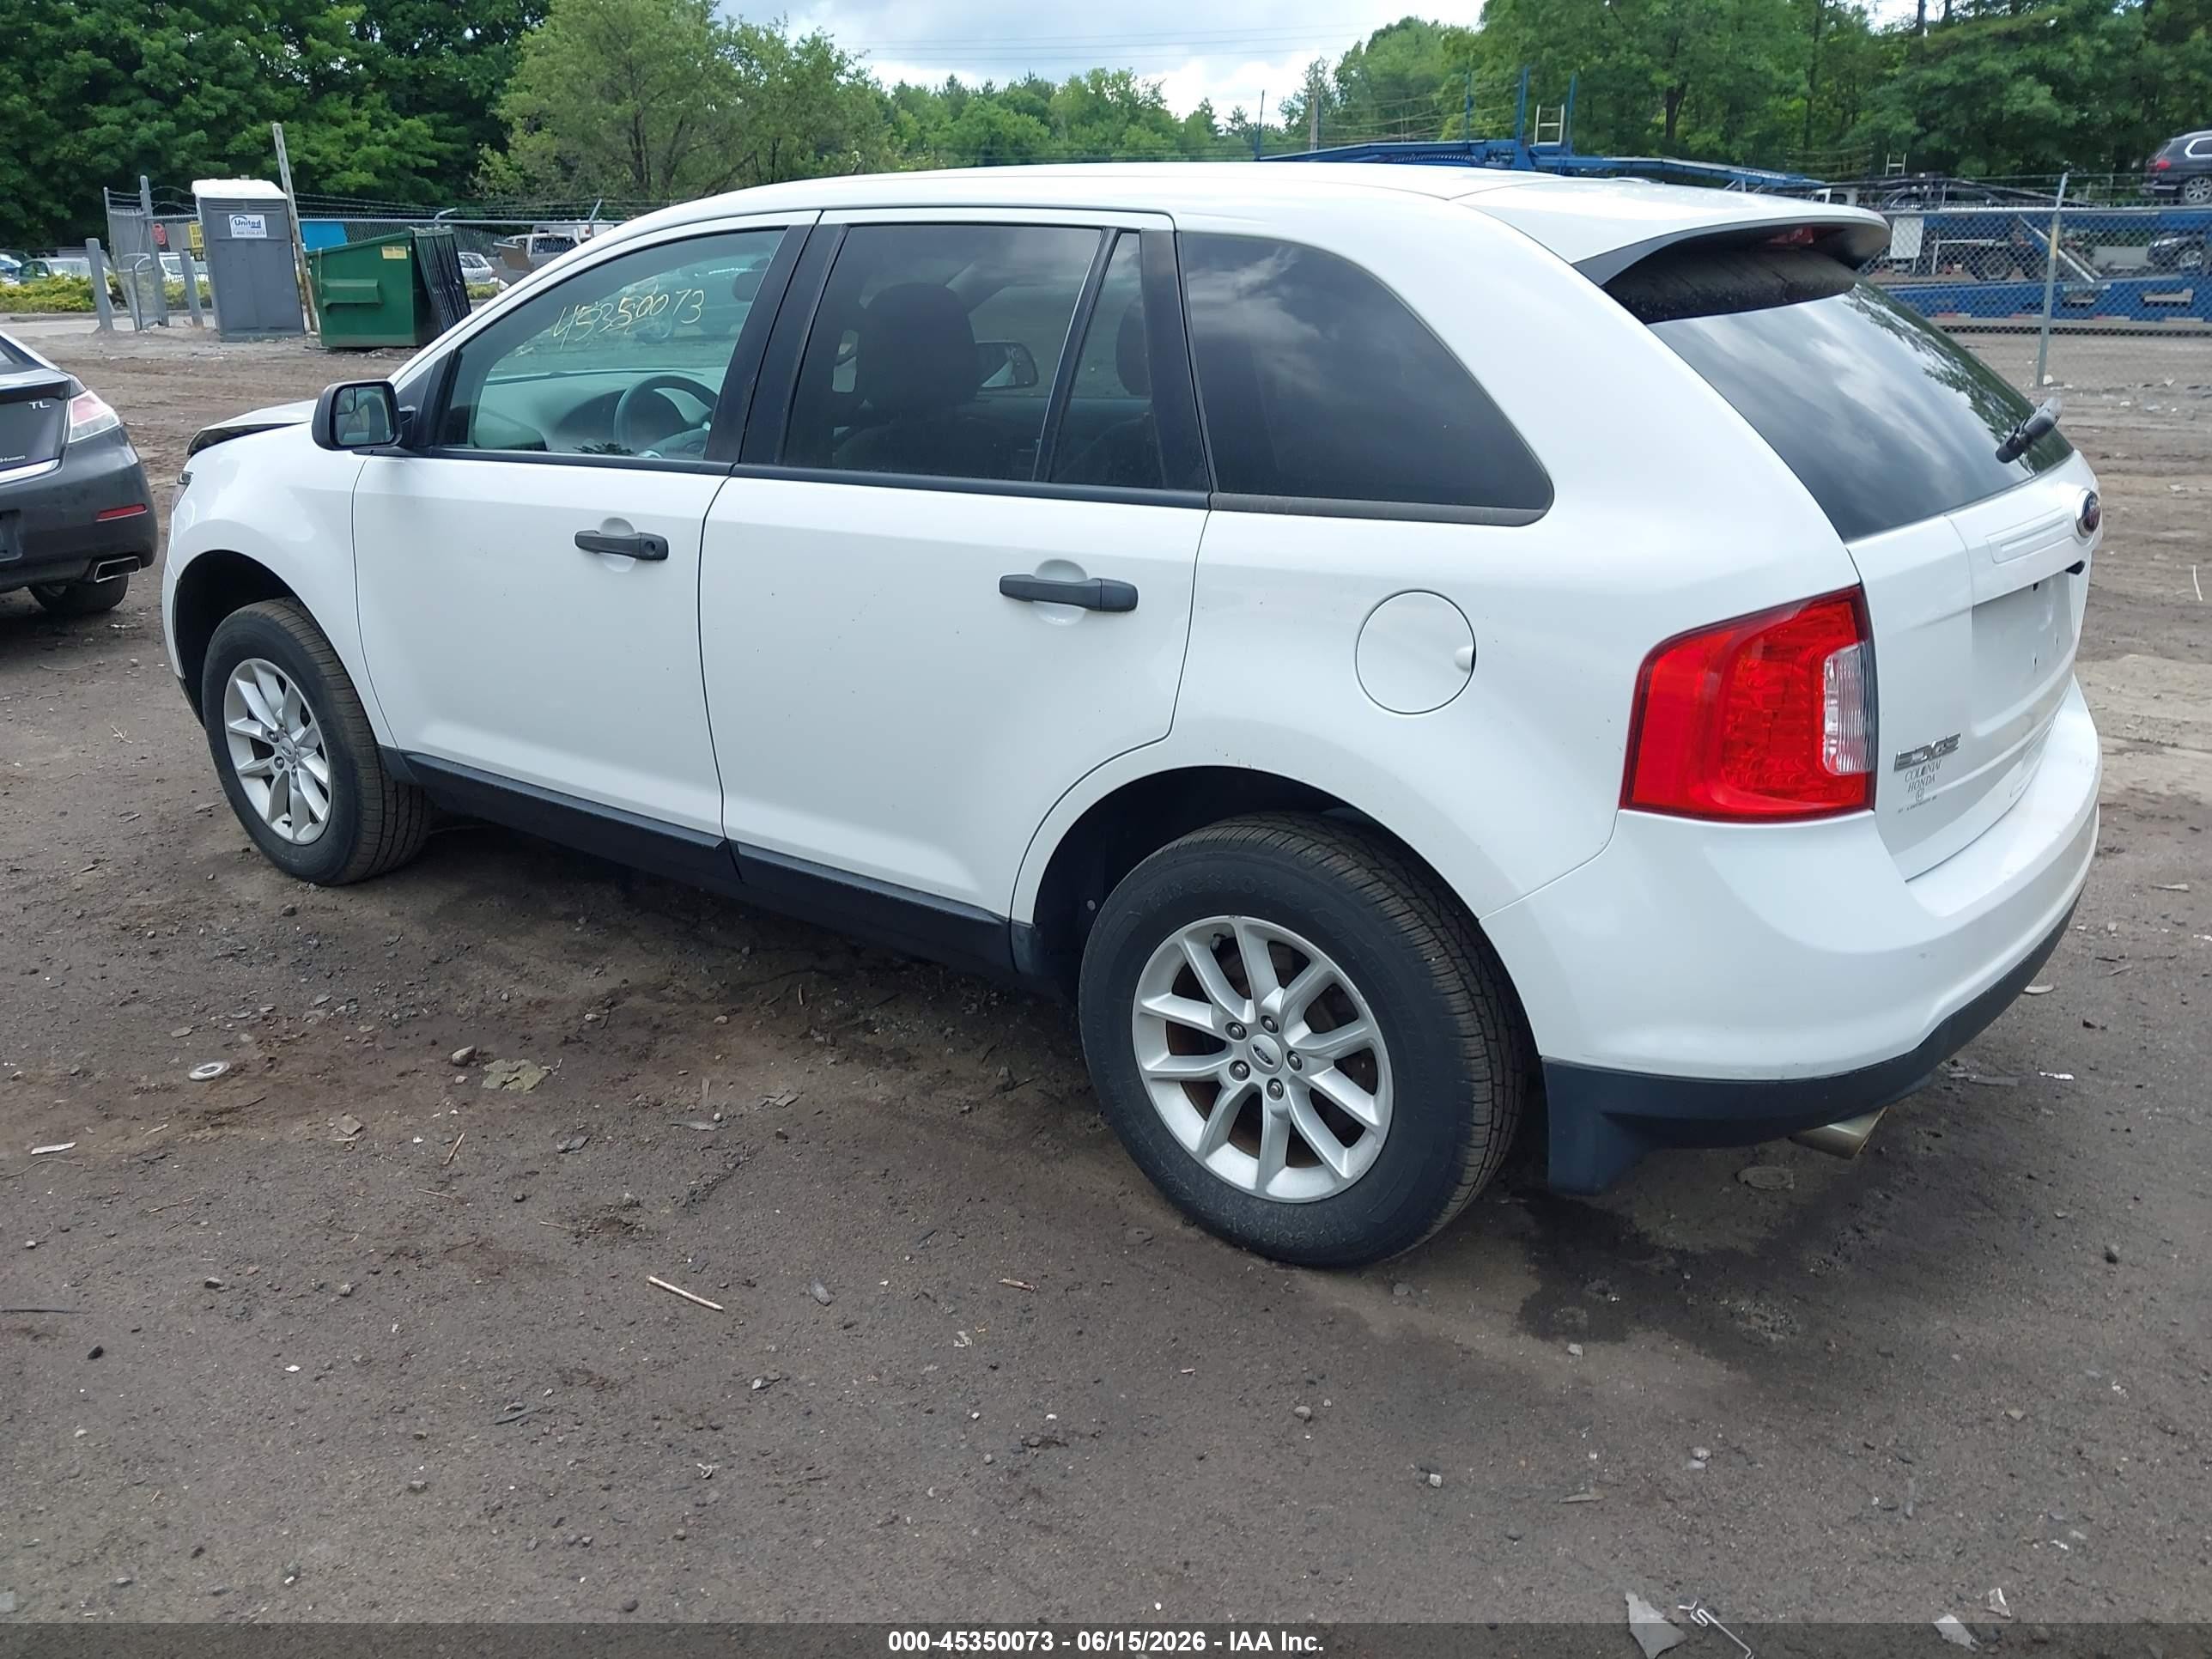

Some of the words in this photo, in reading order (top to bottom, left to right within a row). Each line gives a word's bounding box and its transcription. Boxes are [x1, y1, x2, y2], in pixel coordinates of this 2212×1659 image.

[553, 289, 705, 350] 45350073
[28, 400, 51, 410] TL
[1894, 732, 1960, 773] EDGE
[1908, 775, 1936, 793] HONDA
